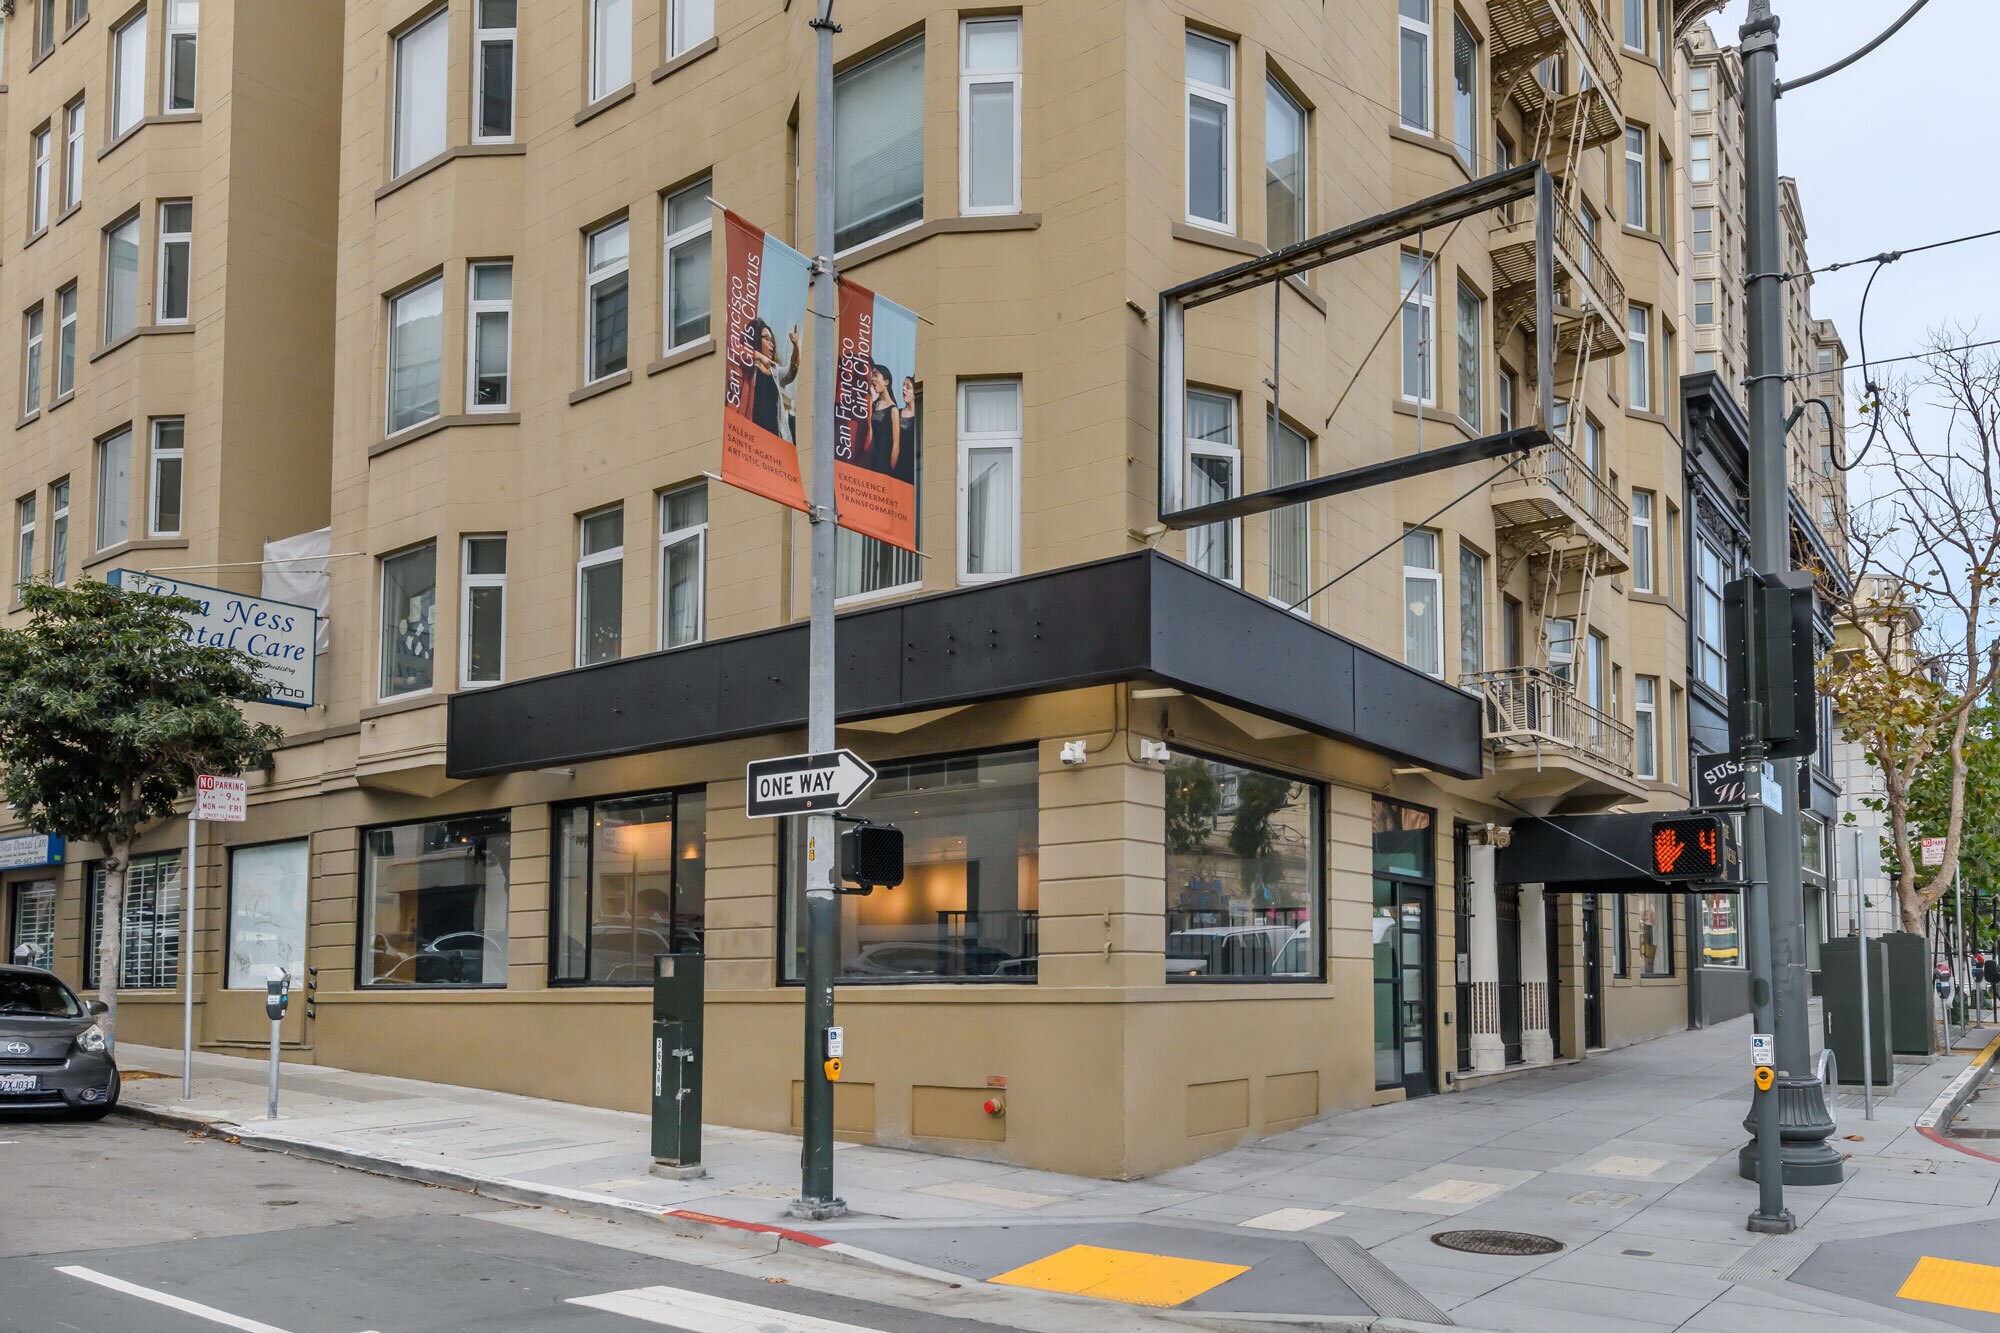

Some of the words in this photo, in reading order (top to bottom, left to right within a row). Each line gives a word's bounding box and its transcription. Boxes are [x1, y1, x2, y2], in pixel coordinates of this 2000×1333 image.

[741, 252, 760, 321] Chorus
[727, 275, 743, 366] Francisco
[740, 325, 755, 367] Girls
[853, 312, 871, 376] Chorus
[727, 370, 741, 408] San
[836, 337, 854, 421] Francisco
[851, 380, 868, 419] Girls
[836, 421, 851, 459] San
[727, 446, 760, 467] ARTISTIC
[762, 462, 798, 484] DIRECTOR
[224, 600, 295, 633] Ness
[247, 633, 305, 661] Care
[200, 776, 214, 789] NO
[215, 781, 244, 791] PARKING
[760, 776, 793, 798] ONE
[800, 770, 835, 793] WAY
[202, 802, 216, 810] MON
[229, 804, 242, 812] FRI
[1699, 828, 1717, 865] 4
